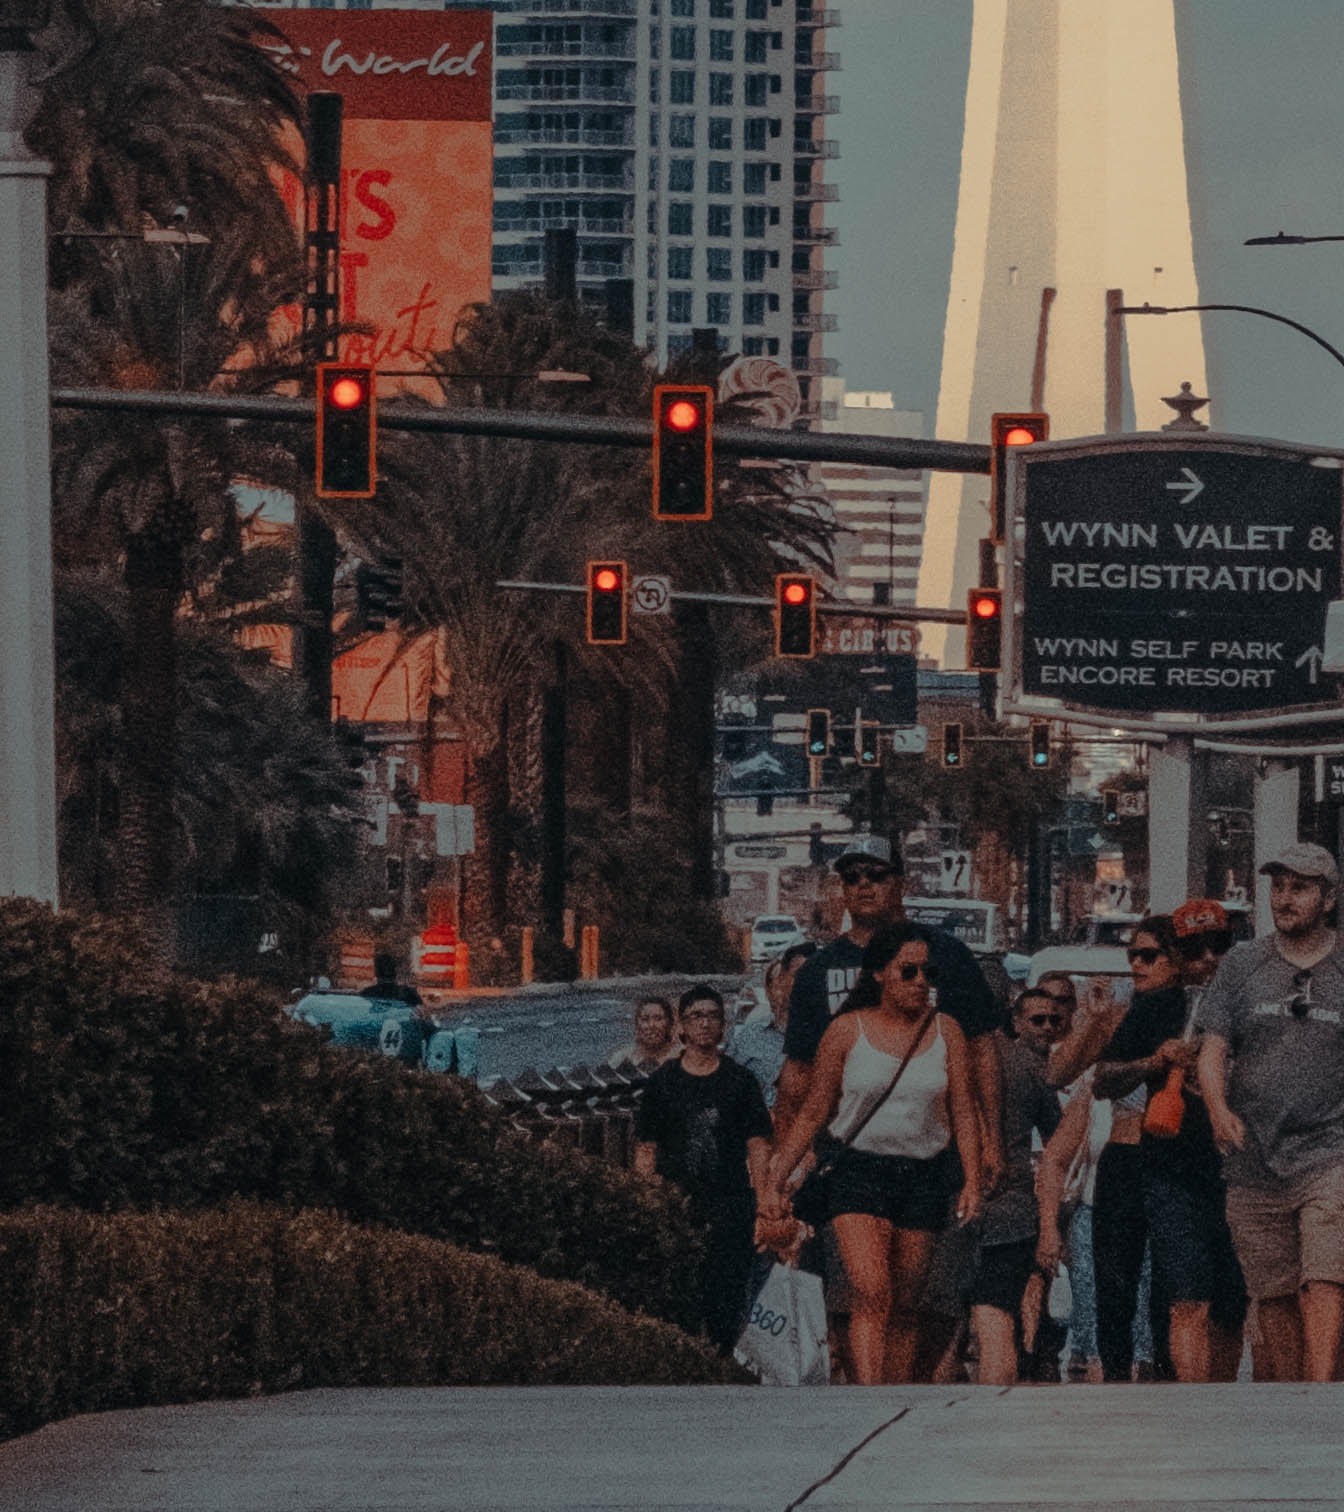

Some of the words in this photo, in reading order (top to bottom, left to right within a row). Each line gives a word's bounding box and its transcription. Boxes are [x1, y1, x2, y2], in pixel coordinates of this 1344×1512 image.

[321, 39, 485, 77] World
[1041, 521, 1157, 548] WYNN
[1173, 523, 1294, 551] VALET
[1307, 526, 1334, 551] &
[1050, 562, 1323, 592] REGISTRATION
[1035, 637, 1119, 658] WYNN
[1130, 639, 1200, 659] SELF
[1210, 641, 1285, 661] PARK
[1040, 665, 1156, 686] ENCORE
[1167, 668, 1276, 688] RESORT
